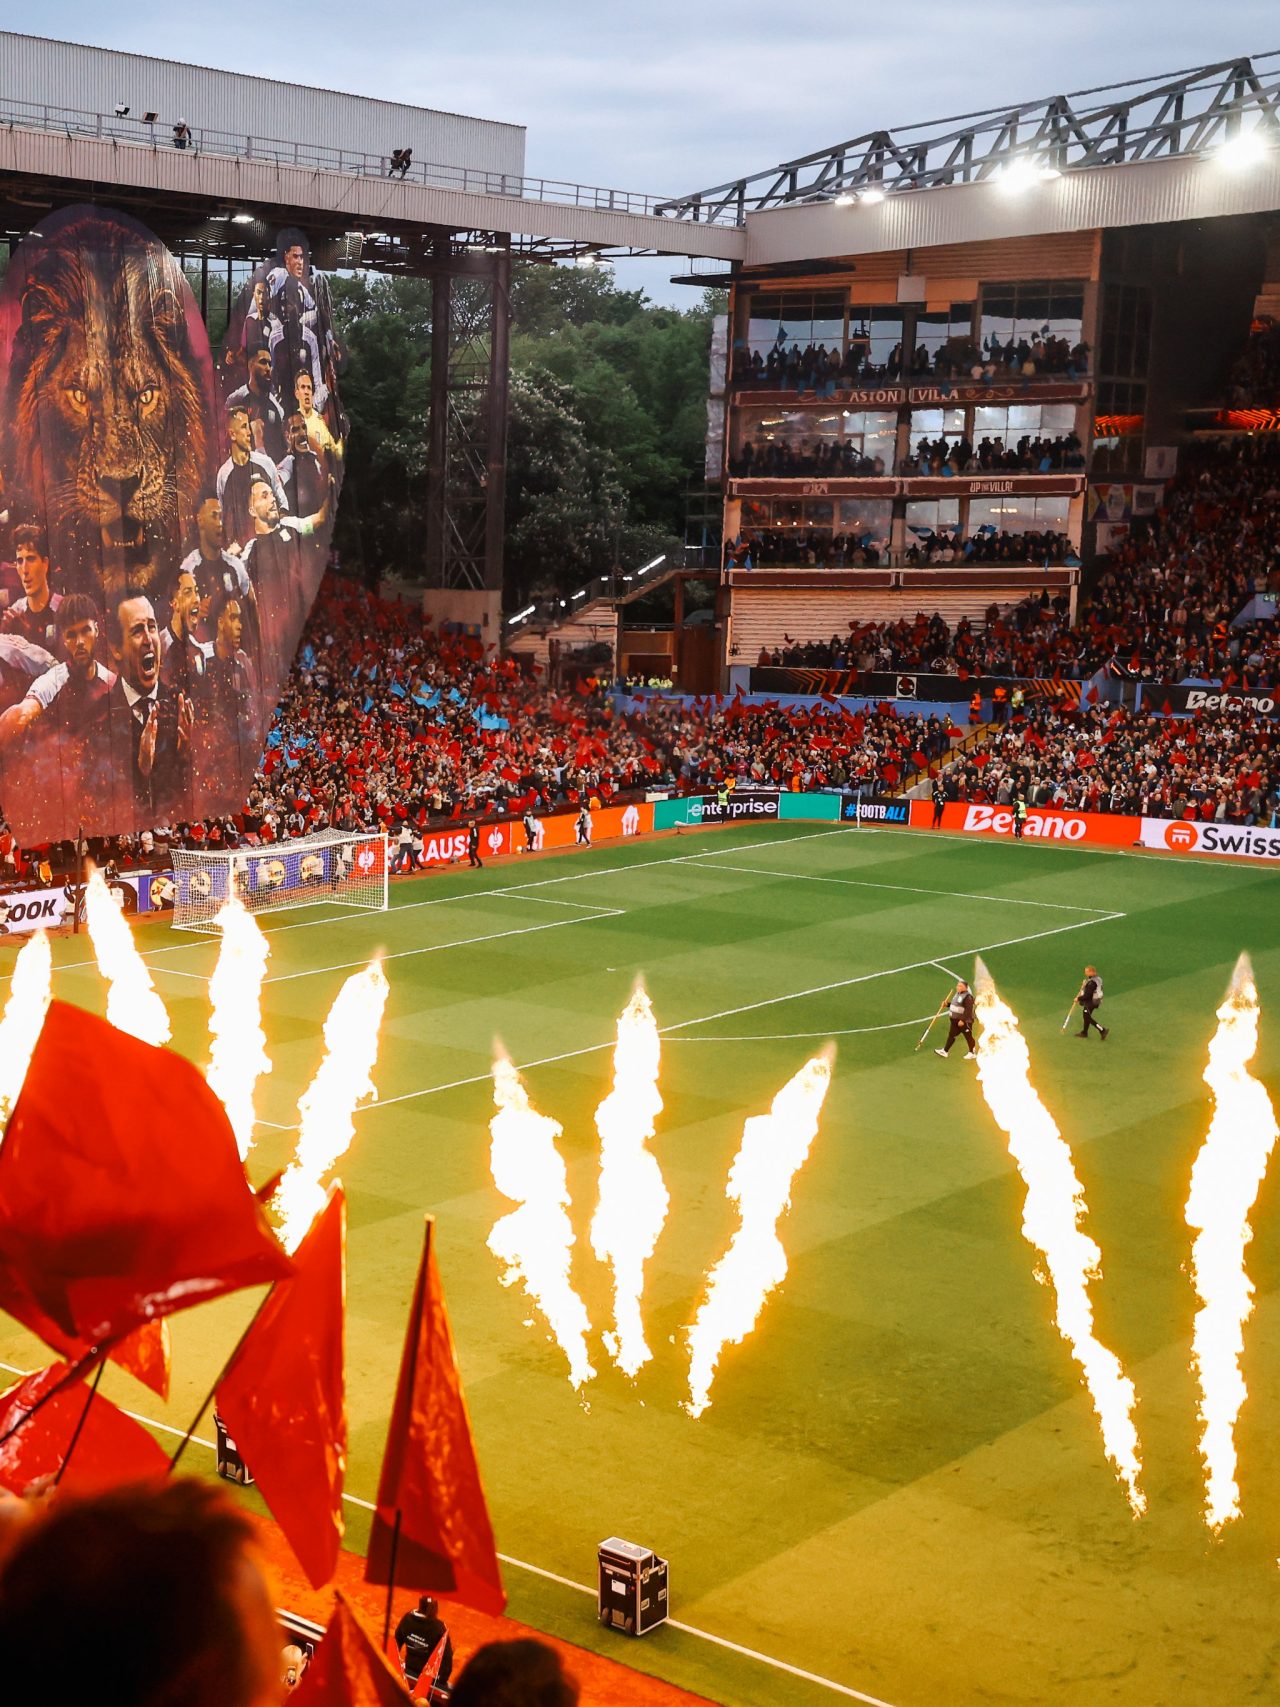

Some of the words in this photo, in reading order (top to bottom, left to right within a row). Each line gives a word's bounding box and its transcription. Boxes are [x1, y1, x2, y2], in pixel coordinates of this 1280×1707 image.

[850, 390, 899, 403] ASTON
[969, 481, 981, 493] UP
[989, 481, 1014, 492] VILLA!
[1185, 691, 1275, 713] Betano
[844, 803, 907, 820] #FOOTBALL
[963, 805, 1087, 840] Beano
[1201, 827, 1280, 856] Swiss
